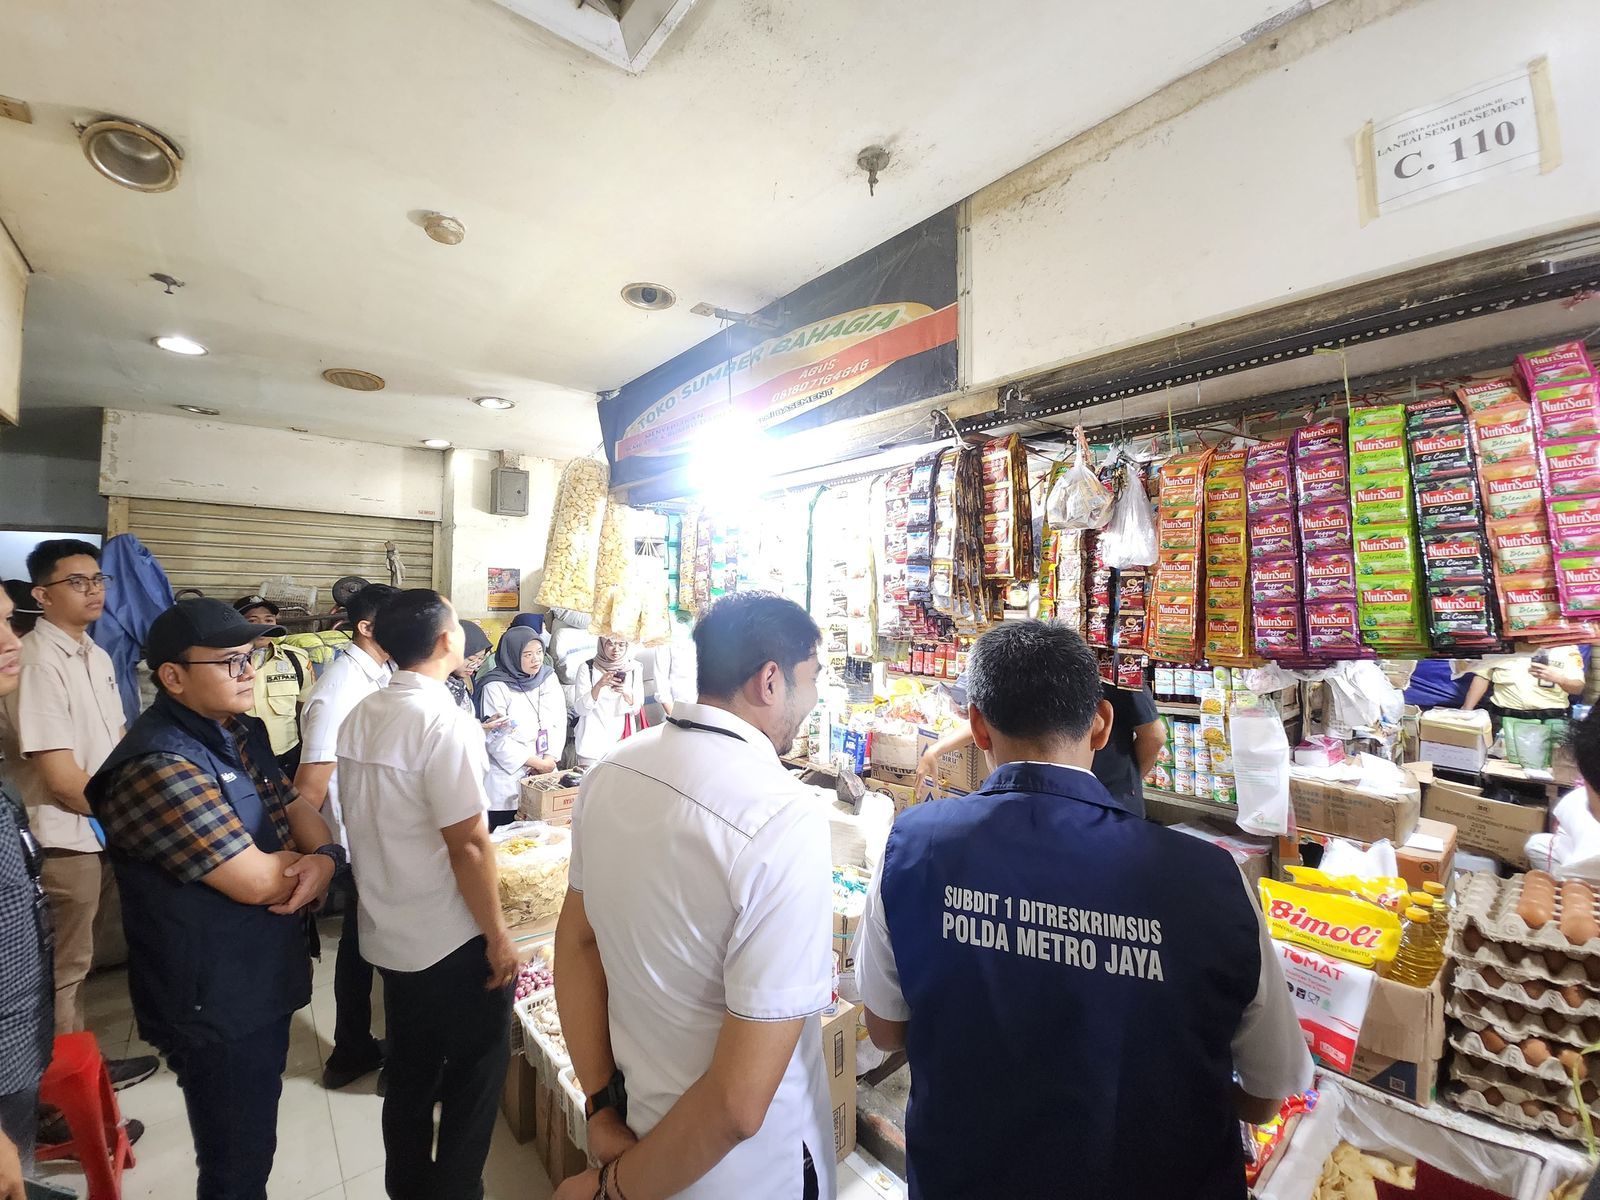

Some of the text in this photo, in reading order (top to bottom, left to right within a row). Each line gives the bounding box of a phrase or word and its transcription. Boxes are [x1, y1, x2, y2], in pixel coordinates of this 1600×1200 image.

[1377, 96, 1527, 157] LANTAI SEMI BASEMENT
[1394, 120, 1516, 180] C. 110
[1531, 350, 1578, 366] NutriSari
[637, 307, 900, 431] TOKO SUMBER BAHAGIA
[799, 358, 837, 379] AGUS
[1465, 380, 1512, 395] NutriSari
[1407, 399, 1452, 411] NutriSari
[1542, 398, 1591, 413] NutriSari
[1301, 427, 1338, 440] NutriSari
[1480, 423, 1528, 439] NutriSari
[1252, 441, 1285, 452] NutriSari
[1355, 439, 1398, 452] NutriSari
[1416, 437, 1462, 452] NutriSari
[1302, 469, 1340, 481] NutriSari
[1165, 477, 1193, 486] NutriSari
[1250, 478, 1284, 490] NutriSari
[1490, 478, 1539, 493] NutriSari
[1209, 491, 1239, 501] NutriSari
[1357, 488, 1400, 502] NutriSari
[1422, 491, 1469, 504] NutriSari
[1305, 517, 1344, 529] NutriSari
[1558, 511, 1600, 525] NutriSa
[1162, 520, 1191, 529] NutriSari
[1254, 524, 1287, 536] NutriSari
[1209, 534, 1239, 544] NutriSari
[1360, 539, 1404, 551] NutriSari
[1498, 533, 1547, 548] NutriSari
[1428, 545, 1477, 557] NutriSari
[1161, 562, 1190, 571] NutriSari
[1308, 564, 1347, 576] NutriSari
[1256, 569, 1291, 581] NutriSari
[1566, 569, 1600, 583] NutriS
[1209, 578, 1239, 588] NutriSari
[1363, 590, 1408, 602] NutriSari
[1508, 590, 1555, 604] NutriSari
[1159, 604, 1189, 615] NutriSari
[1434, 598, 1480, 610] NutriSari
[1257, 616, 1294, 627] NutriSari
[1311, 614, 1350, 626] NutriSari
[1209, 621, 1237, 632] NutriSari
[267, 674, 296, 682] SATPAM
[944, 885, 1163, 945] SUBDIT 1 DITRESKRIMSUS
[1268, 899, 1383, 948] Bimoli
[1295, 930, 1320, 944] GORENG
[942, 911, 1164, 982] POLDA METRO JAYA
[1281, 946, 1344, 980] TOMAT
